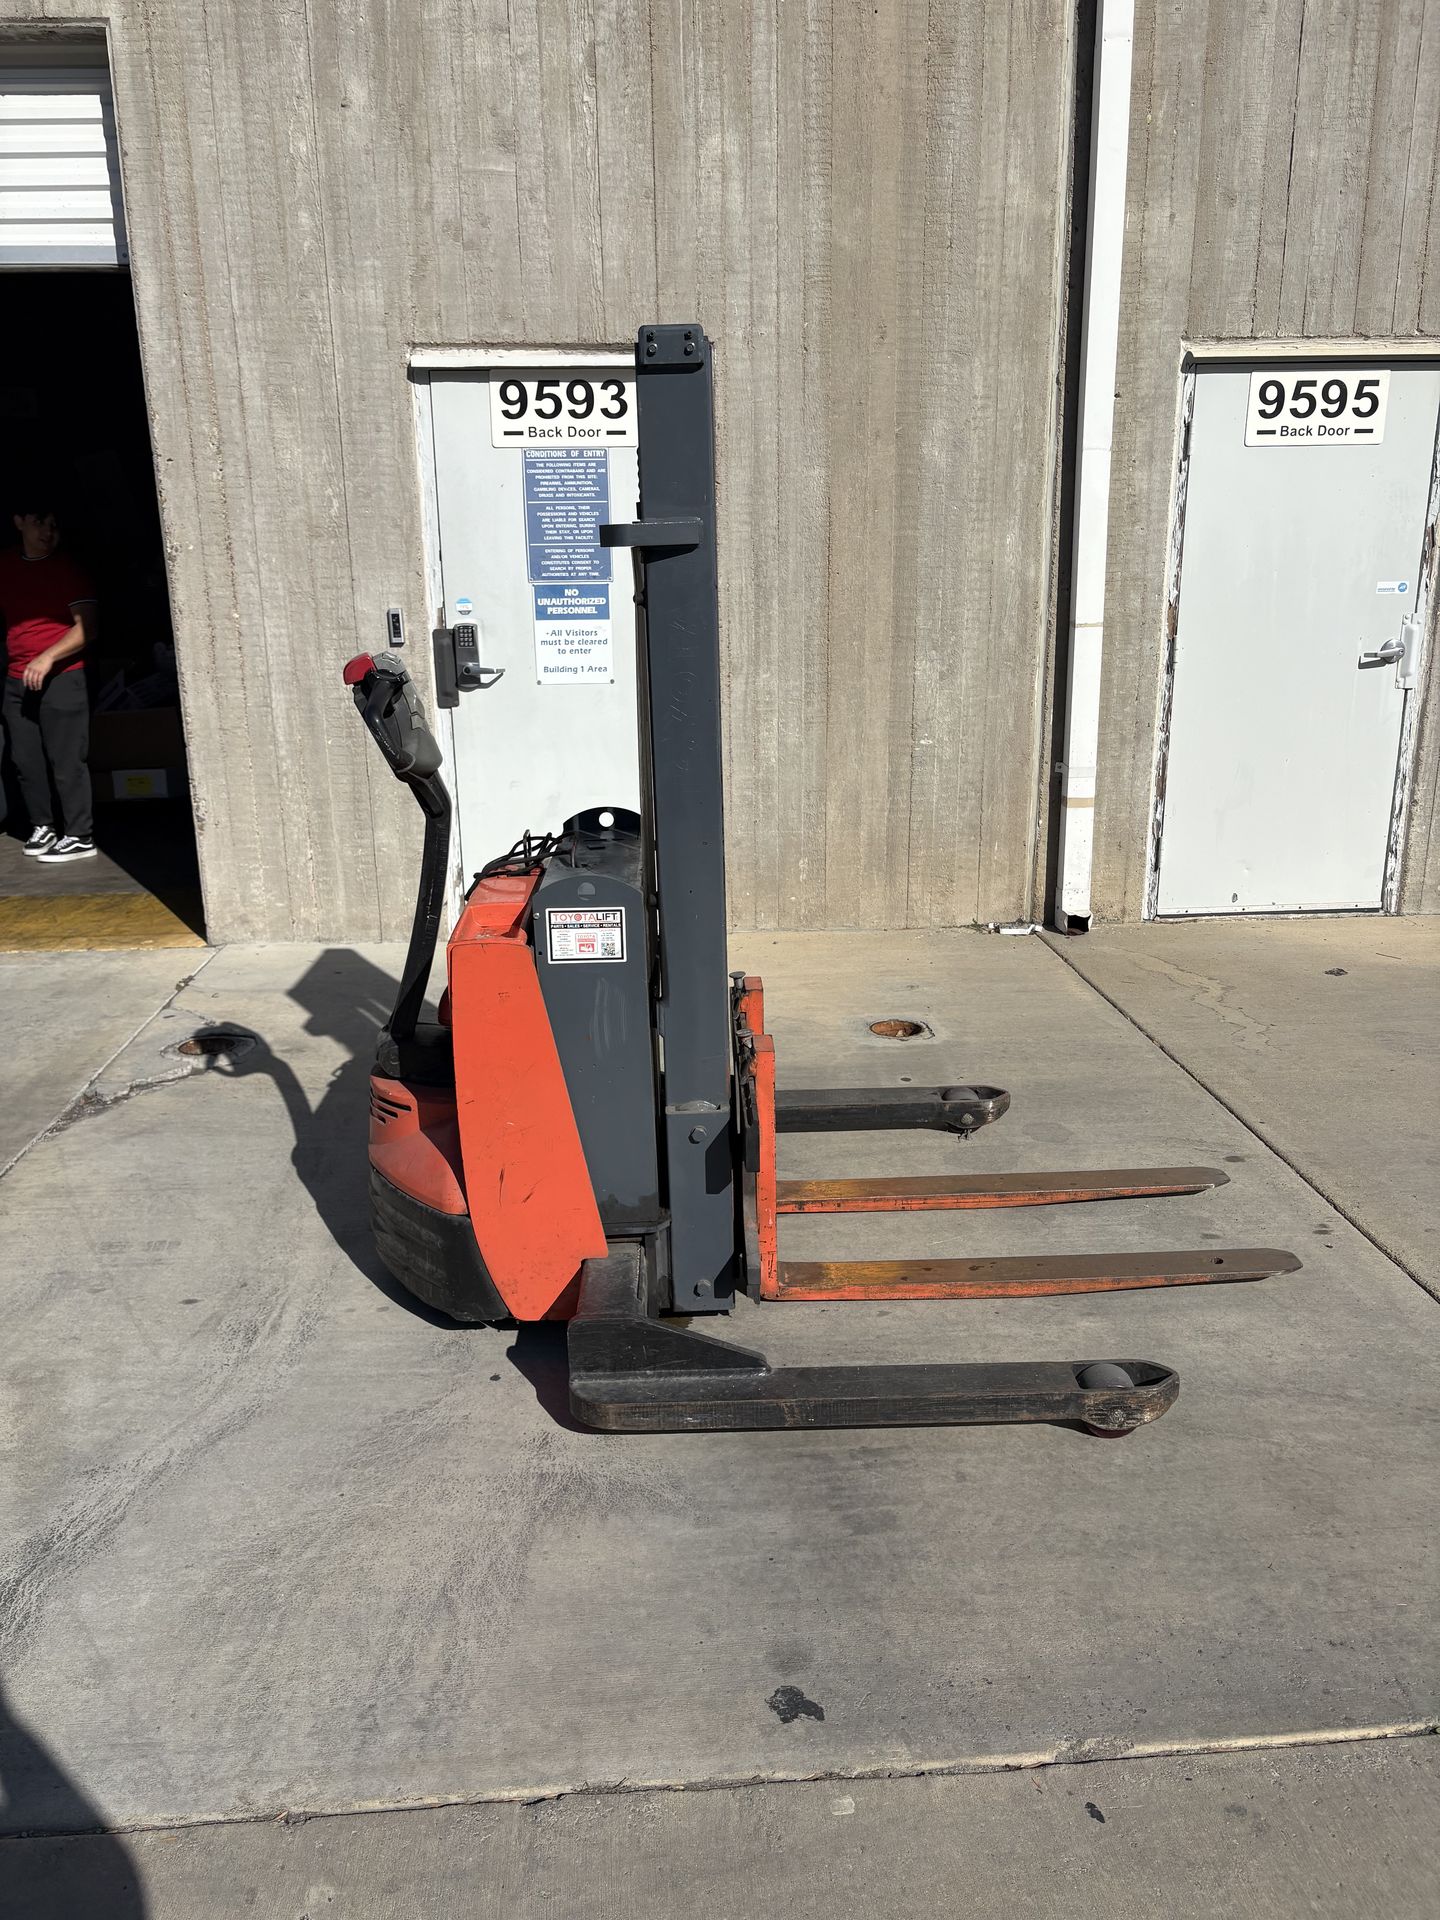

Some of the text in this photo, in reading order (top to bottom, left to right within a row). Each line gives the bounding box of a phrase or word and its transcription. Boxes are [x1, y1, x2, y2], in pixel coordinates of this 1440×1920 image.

[499, 379, 628, 419] 9593
[1258, 379, 1380, 419] 9595
[528, 426, 601, 438] Back Door
[1280, 425, 1350, 437] Back Door
[526, 450, 566, 458] CONDITIONS
[538, 597, 606, 605] UNAUTHORIZED
[547, 607, 597, 615] PERSONNEL
[544, 666, 578, 674] Building
[588, 665, 608, 673] Area
